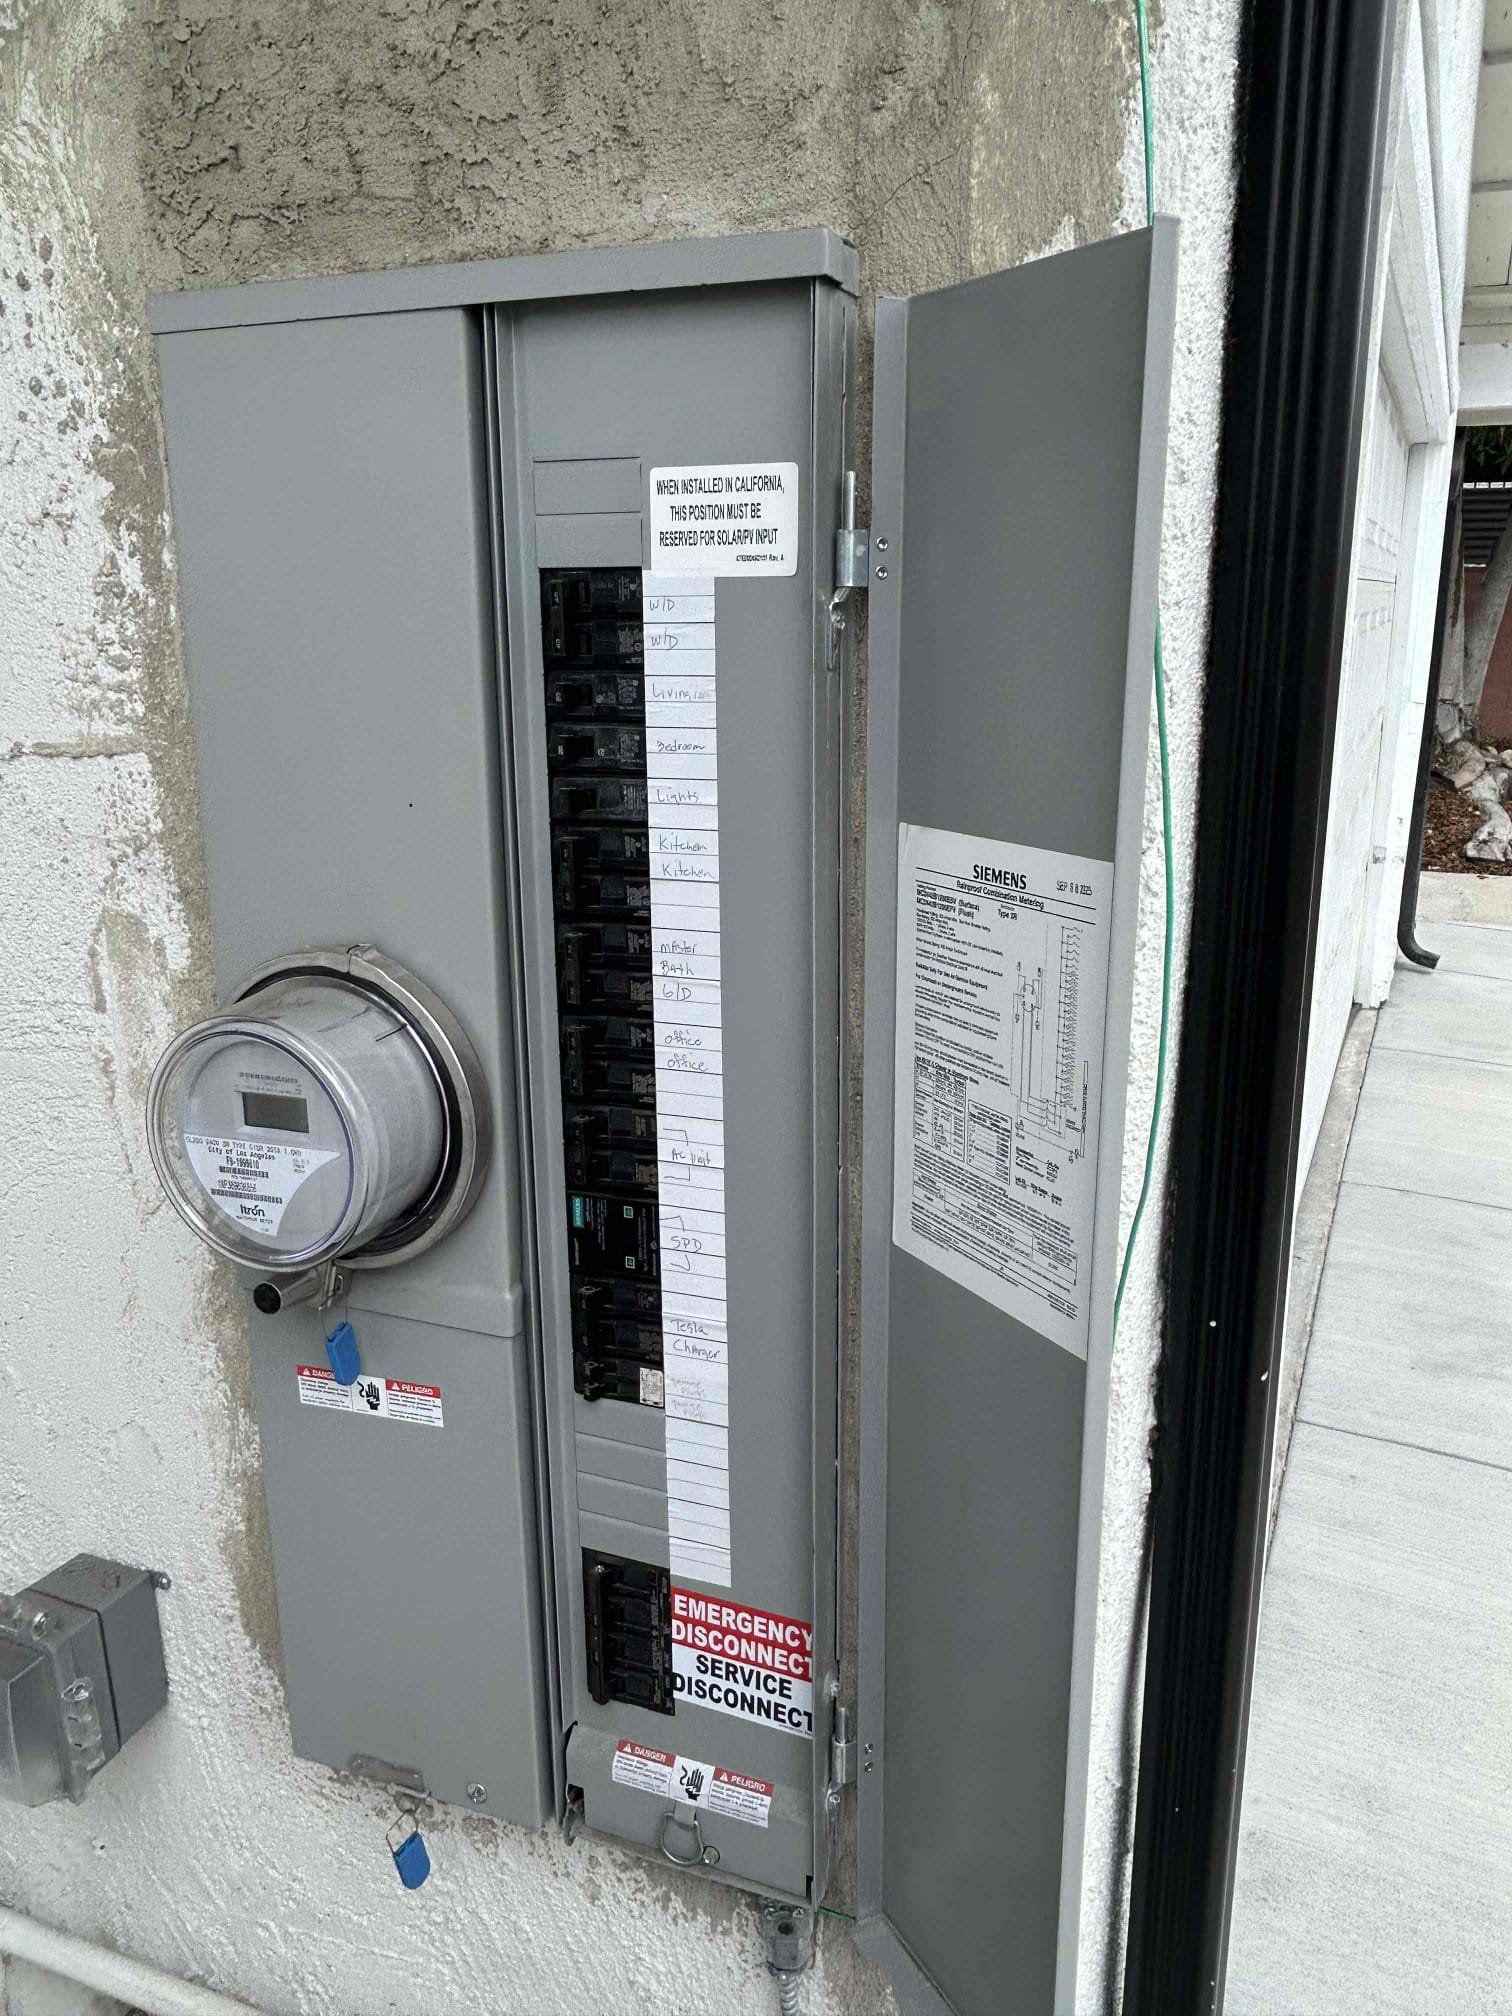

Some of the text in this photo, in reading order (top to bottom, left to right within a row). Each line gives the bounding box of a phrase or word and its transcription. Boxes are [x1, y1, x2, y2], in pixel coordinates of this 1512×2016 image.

[656, 474, 786, 496] WHEN INSTALLED IN CALIFORNIA,
[670, 502, 762, 522] THIS POSITION MUST BE
[659, 528, 779, 547] RESERVED FOR SOLAR/PV INPUT
[659, 832, 708, 852] Kitchen
[662, 860, 716, 879] Kitchen
[973, 864, 1027, 890] SIEMENS
[983, 886, 1018, 902] Combination
[1018, 894, 1045, 911] Metering
[674, 1593, 814, 1652] EMERGENCY
[672, 1618, 814, 1679] DISCONNECT
[695, 1654, 793, 1700] SERVICE
[672, 1673, 814, 1733] DISCONNECT
[634, 1746, 767, 1793] DANGER PELIGRO
